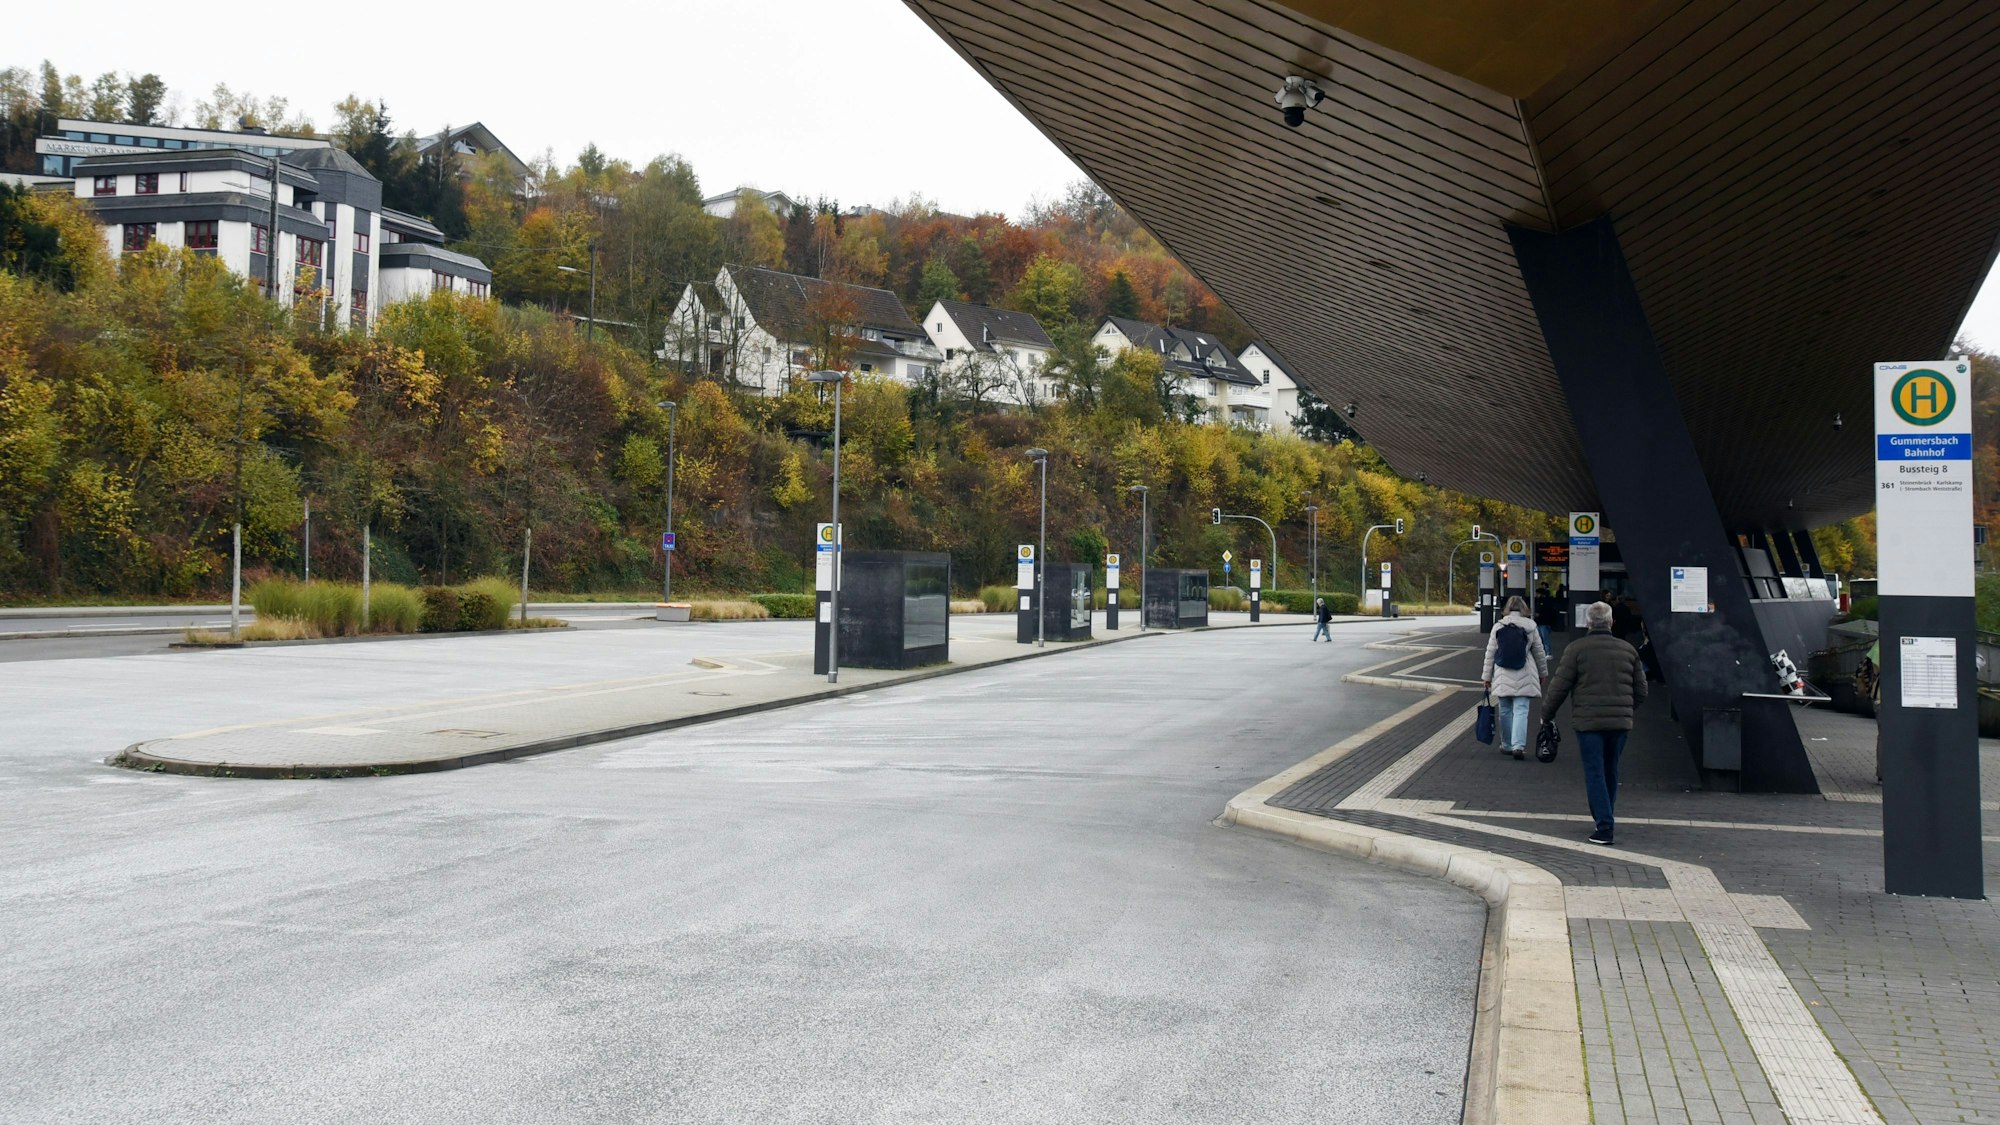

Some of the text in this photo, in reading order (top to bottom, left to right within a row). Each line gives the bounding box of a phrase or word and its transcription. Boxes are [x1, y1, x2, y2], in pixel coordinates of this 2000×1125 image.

[1911, 382, 1936, 413] H
[1890, 436, 1958, 446] Gummersbach
[1904, 448, 1946, 457] Bahnhof
[1900, 465, 1939, 475] Bussteig
[1580, 519, 1588, 530] H
